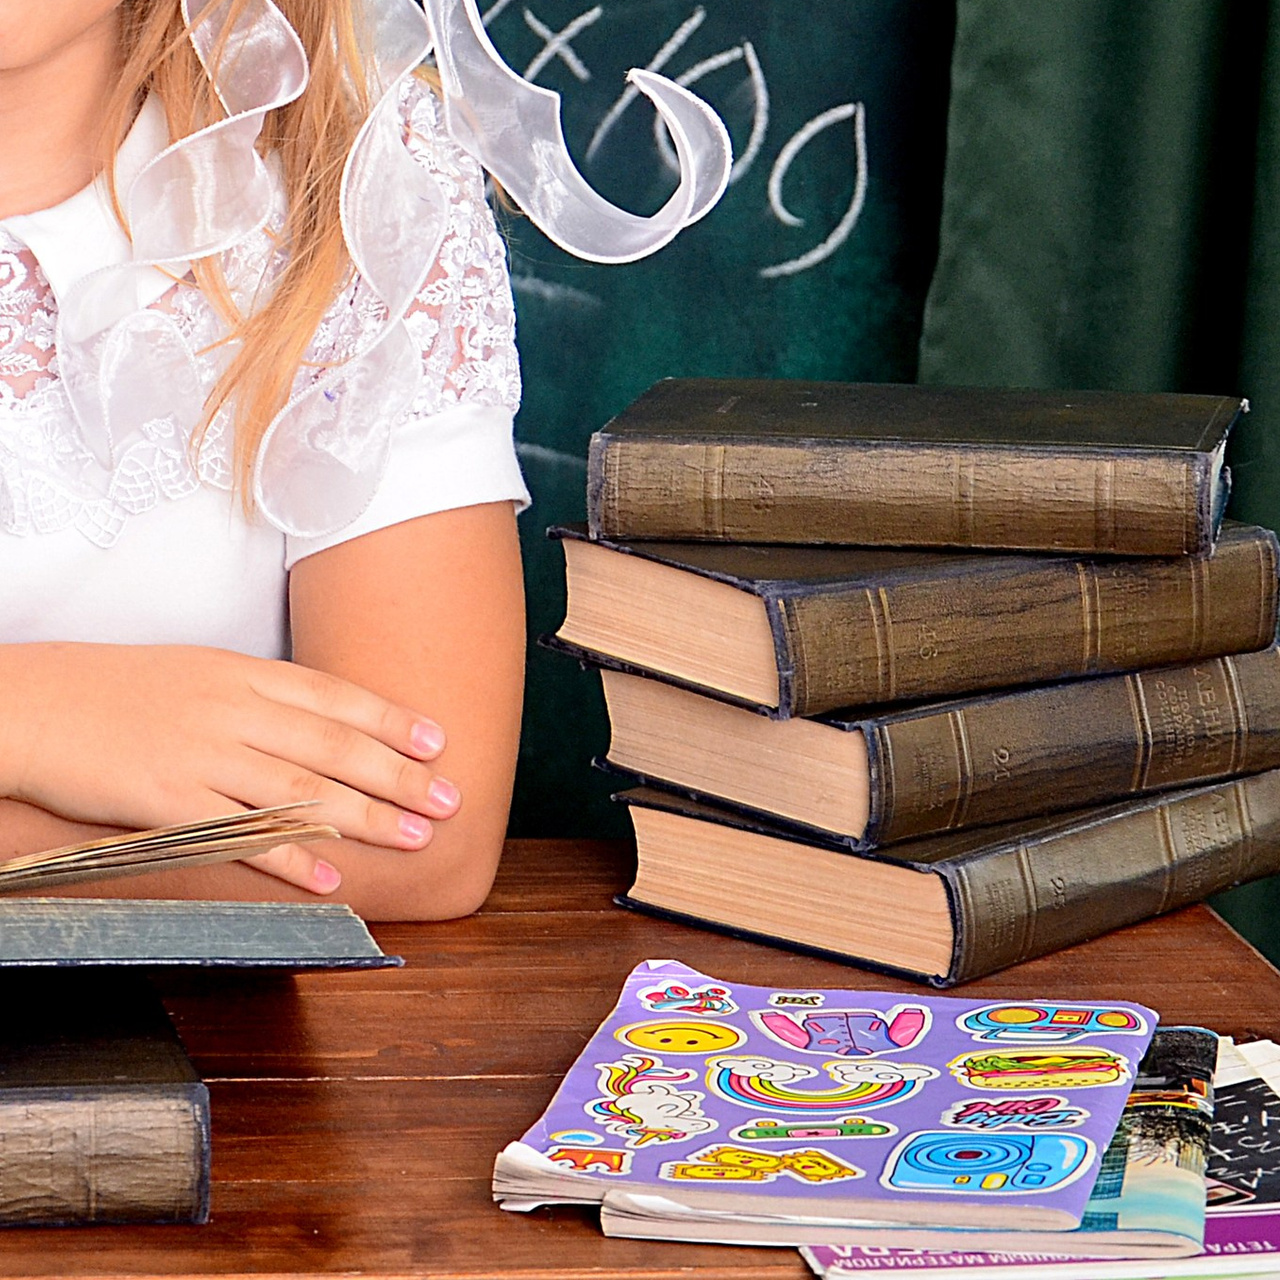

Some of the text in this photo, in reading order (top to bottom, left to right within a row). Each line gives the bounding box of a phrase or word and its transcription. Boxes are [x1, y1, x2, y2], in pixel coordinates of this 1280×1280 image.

[919, 624, 938, 660] 46
[1192, 668, 1221, 768] ЛЕНИН
[992, 748, 1010, 781] 21
[958, 1098, 1061, 1118] Girl
[954, 1109, 1082, 1128] Baby
[1205, 1240, 1278, 1254] ТЕТРА
[833, 1253, 985, 1269] МАТЕРИАЛОМ
